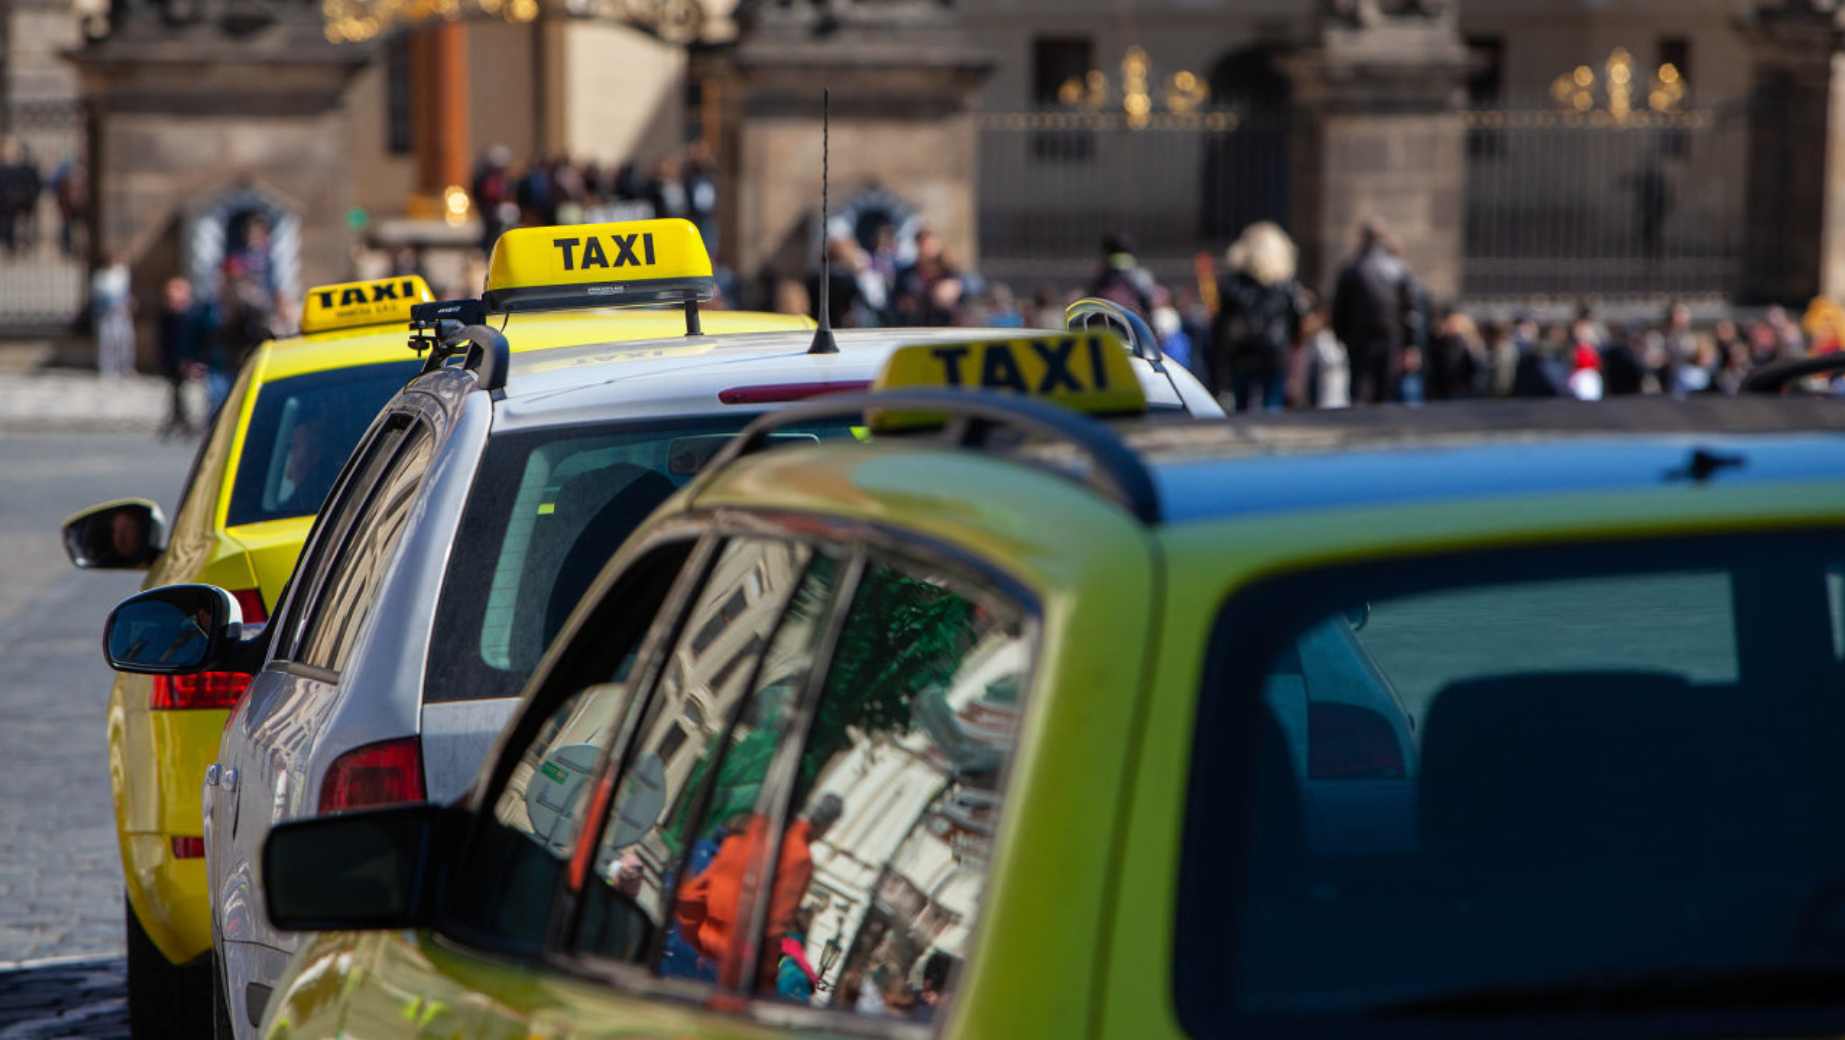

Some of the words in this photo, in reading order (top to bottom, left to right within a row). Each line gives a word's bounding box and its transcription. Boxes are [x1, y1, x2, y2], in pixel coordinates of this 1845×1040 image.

[553, 232, 656, 271] TAXI
[317, 281, 413, 308] TAXI
[931, 335, 1108, 392] TAXI
